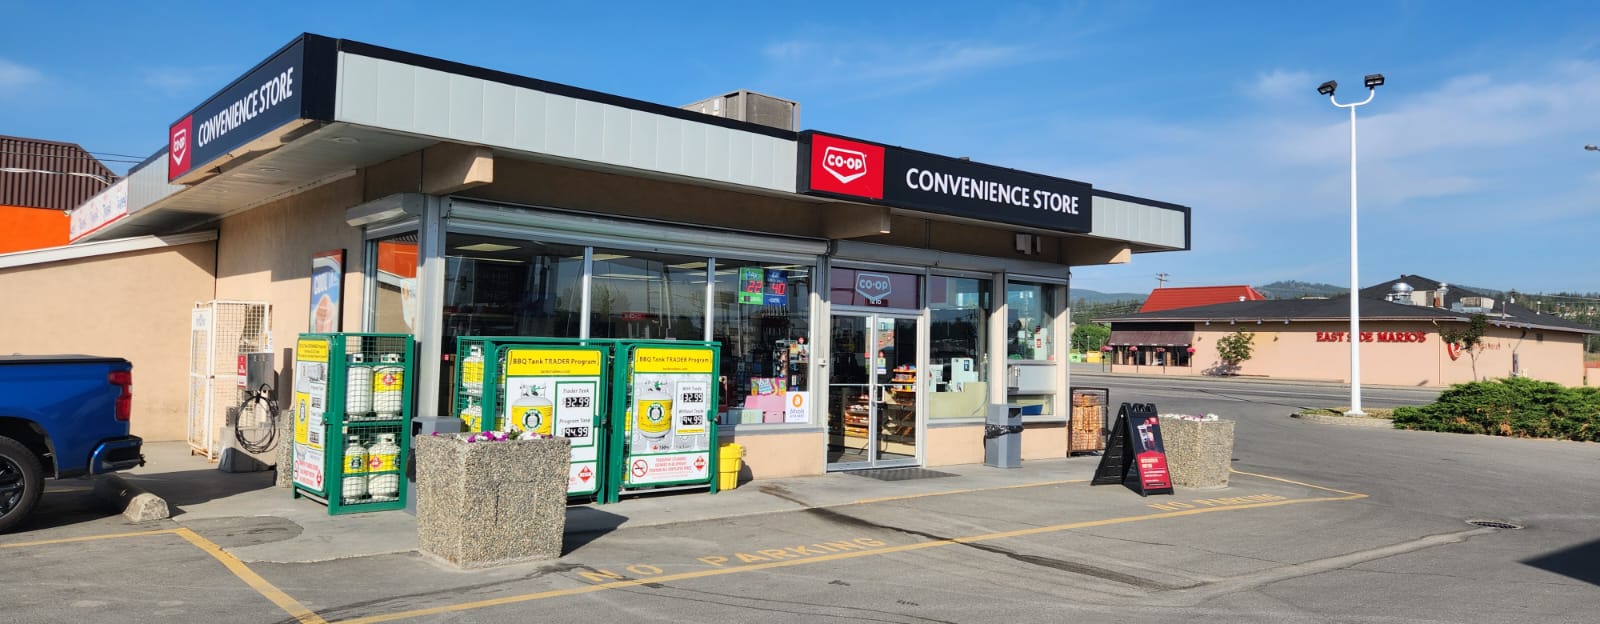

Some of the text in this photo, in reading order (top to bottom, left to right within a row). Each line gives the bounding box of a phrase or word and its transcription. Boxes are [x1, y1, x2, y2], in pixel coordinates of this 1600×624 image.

[198, 66, 294, 148] CONVENIENCE STORE
[905, 167, 1080, 215] CONVENIENCE STORE
[746, 280, 762, 293] 22
[771, 282, 786, 295] 40
[1316, 331, 1344, 343] EAST
[1347, 331, 1373, 343] SDE
[571, 359, 597, 367] Program
[1147, 493, 1287, 511] NO PARKING
[578, 537, 888, 582] NO PARKING
